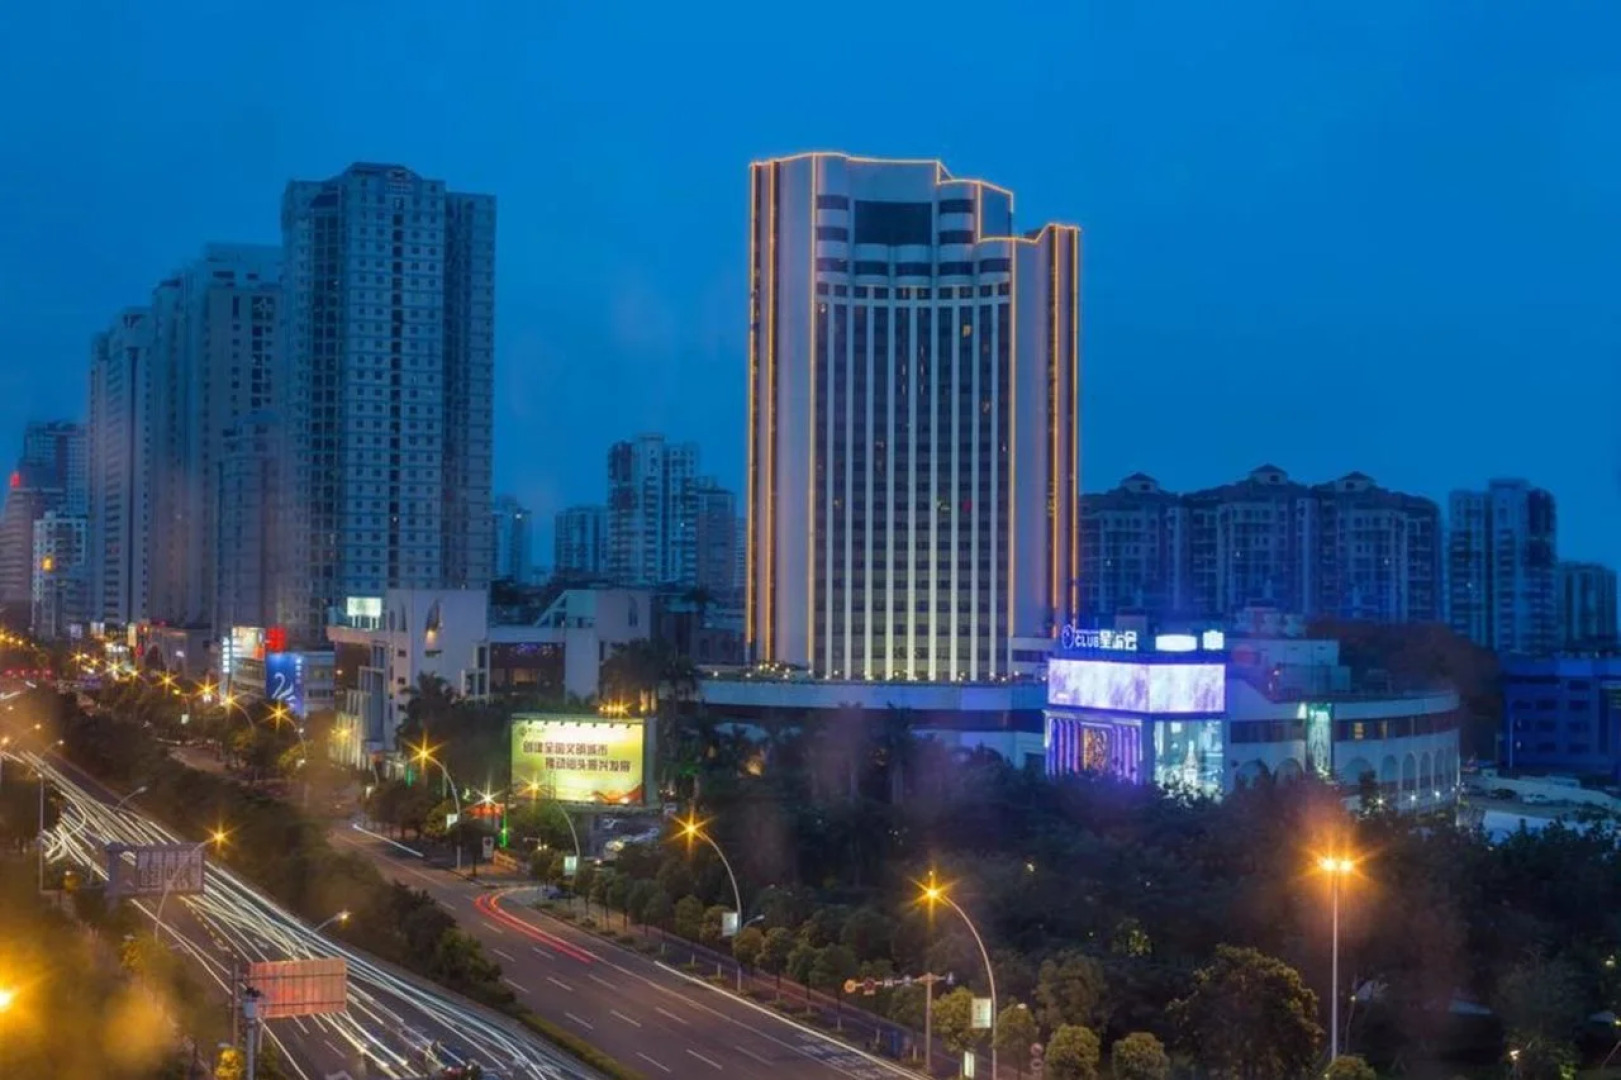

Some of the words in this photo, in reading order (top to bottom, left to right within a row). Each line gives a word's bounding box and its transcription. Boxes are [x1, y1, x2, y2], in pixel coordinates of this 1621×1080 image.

[523, 741, 608, 756] 创建全国文明城市
[546, 757, 631, 772] 推动汕头振兴发展
